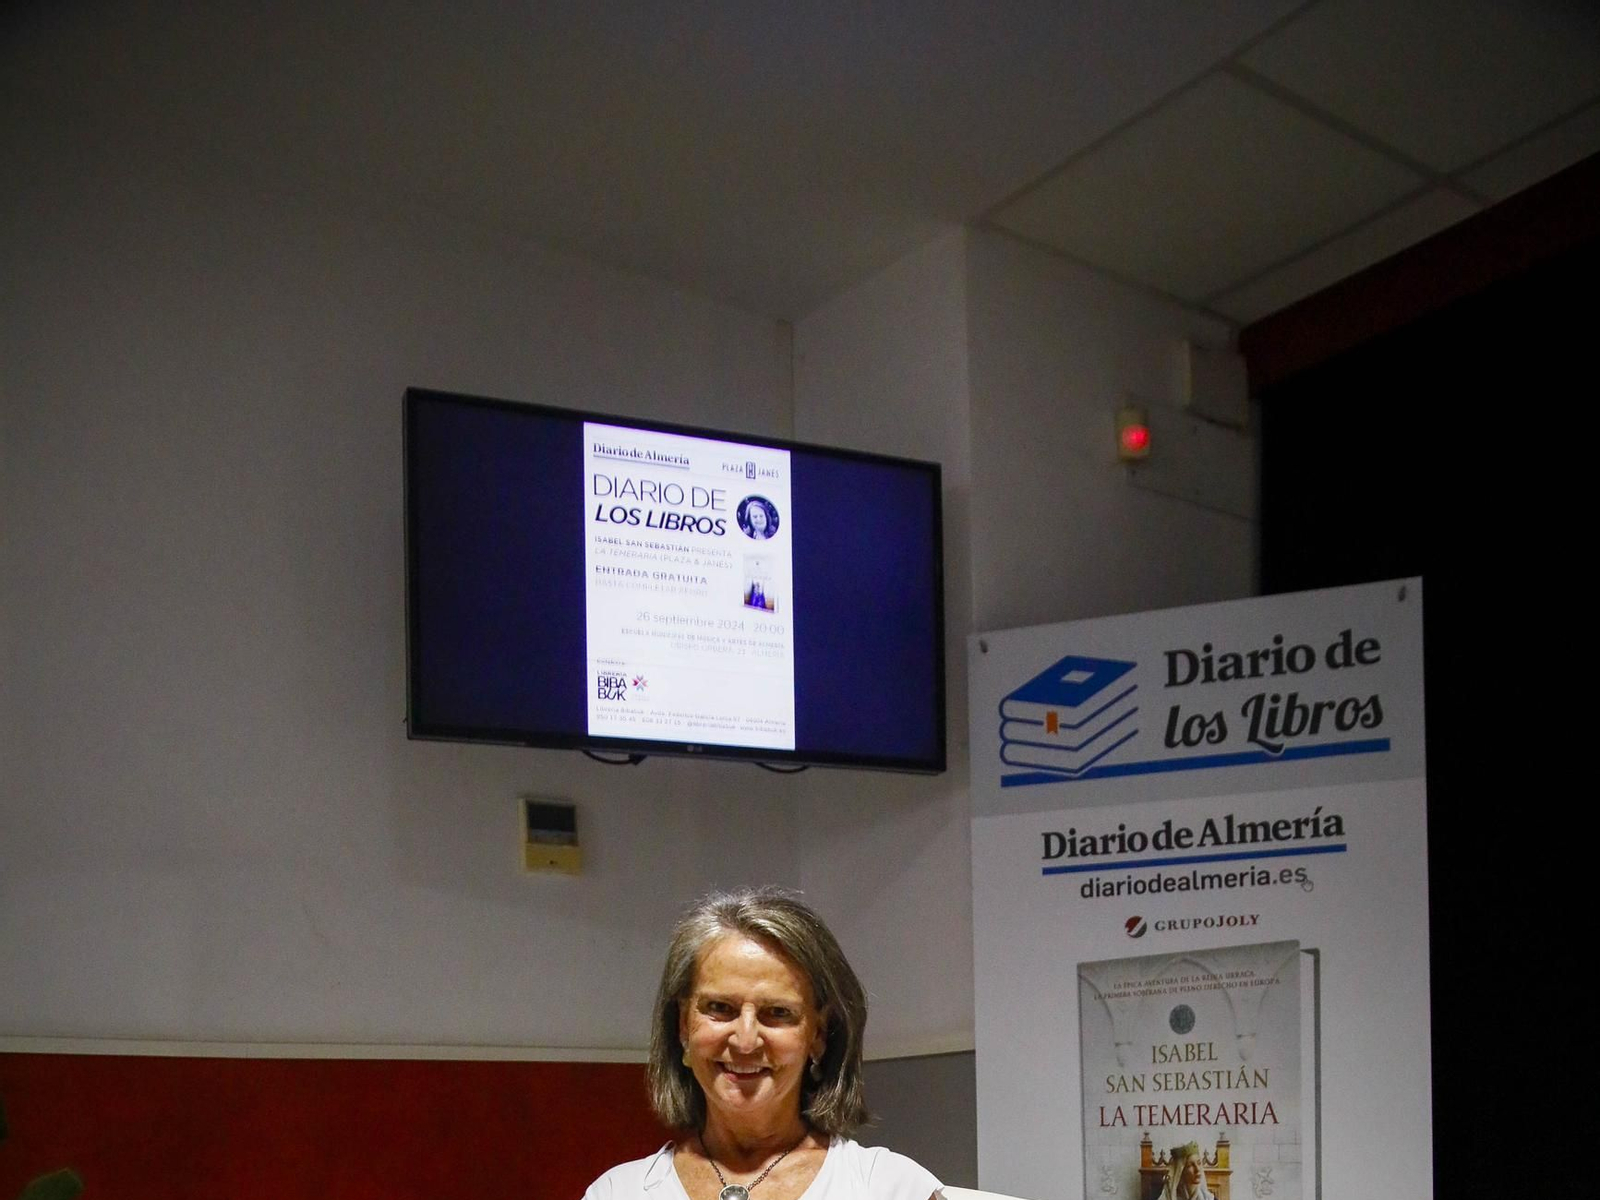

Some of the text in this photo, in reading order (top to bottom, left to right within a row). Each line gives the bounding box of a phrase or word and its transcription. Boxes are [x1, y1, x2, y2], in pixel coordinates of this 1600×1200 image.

[593, 442, 629, 457] Diario
[644, 450, 690, 466] Almería
[722, 462, 743, 473] PLAZA
[593, 473, 727, 512] DIARIO DE
[595, 503, 727, 536] LOS LIBROS
[594, 536, 622, 546] ISABEL
[626, 539, 642, 548] SAN
[594, 547, 606, 555] LA
[608, 547, 658, 561] TEMERARIA
[595, 564, 708, 585] ENTRADA GRATUITA
[636, 611, 651, 622] 26
[653, 613, 714, 629] septiembre
[717, 619, 745, 632] 2024
[1163, 628, 1381, 688] Diario de
[597, 676, 627, 689] BIBA
[597, 687, 627, 701] BUK
[1163, 691, 1384, 754] los Libros
[1041, 806, 1346, 860] Diario de Almería
[1080, 865, 1307, 899] diariodealmeria.es
[1133, 988, 1167, 997] SOBERANA
[1203, 981, 1238, 990] DERECHO
[1250, 977, 1281, 986] EUROPA
[1144, 976, 1179, 986] AVENTURA
[1151, 1042, 1219, 1064] ISABEL
[1106, 1065, 1270, 1094] SAN SEBASTIÁN
[1099, 1101, 1280, 1127] LA TEMERARIA
